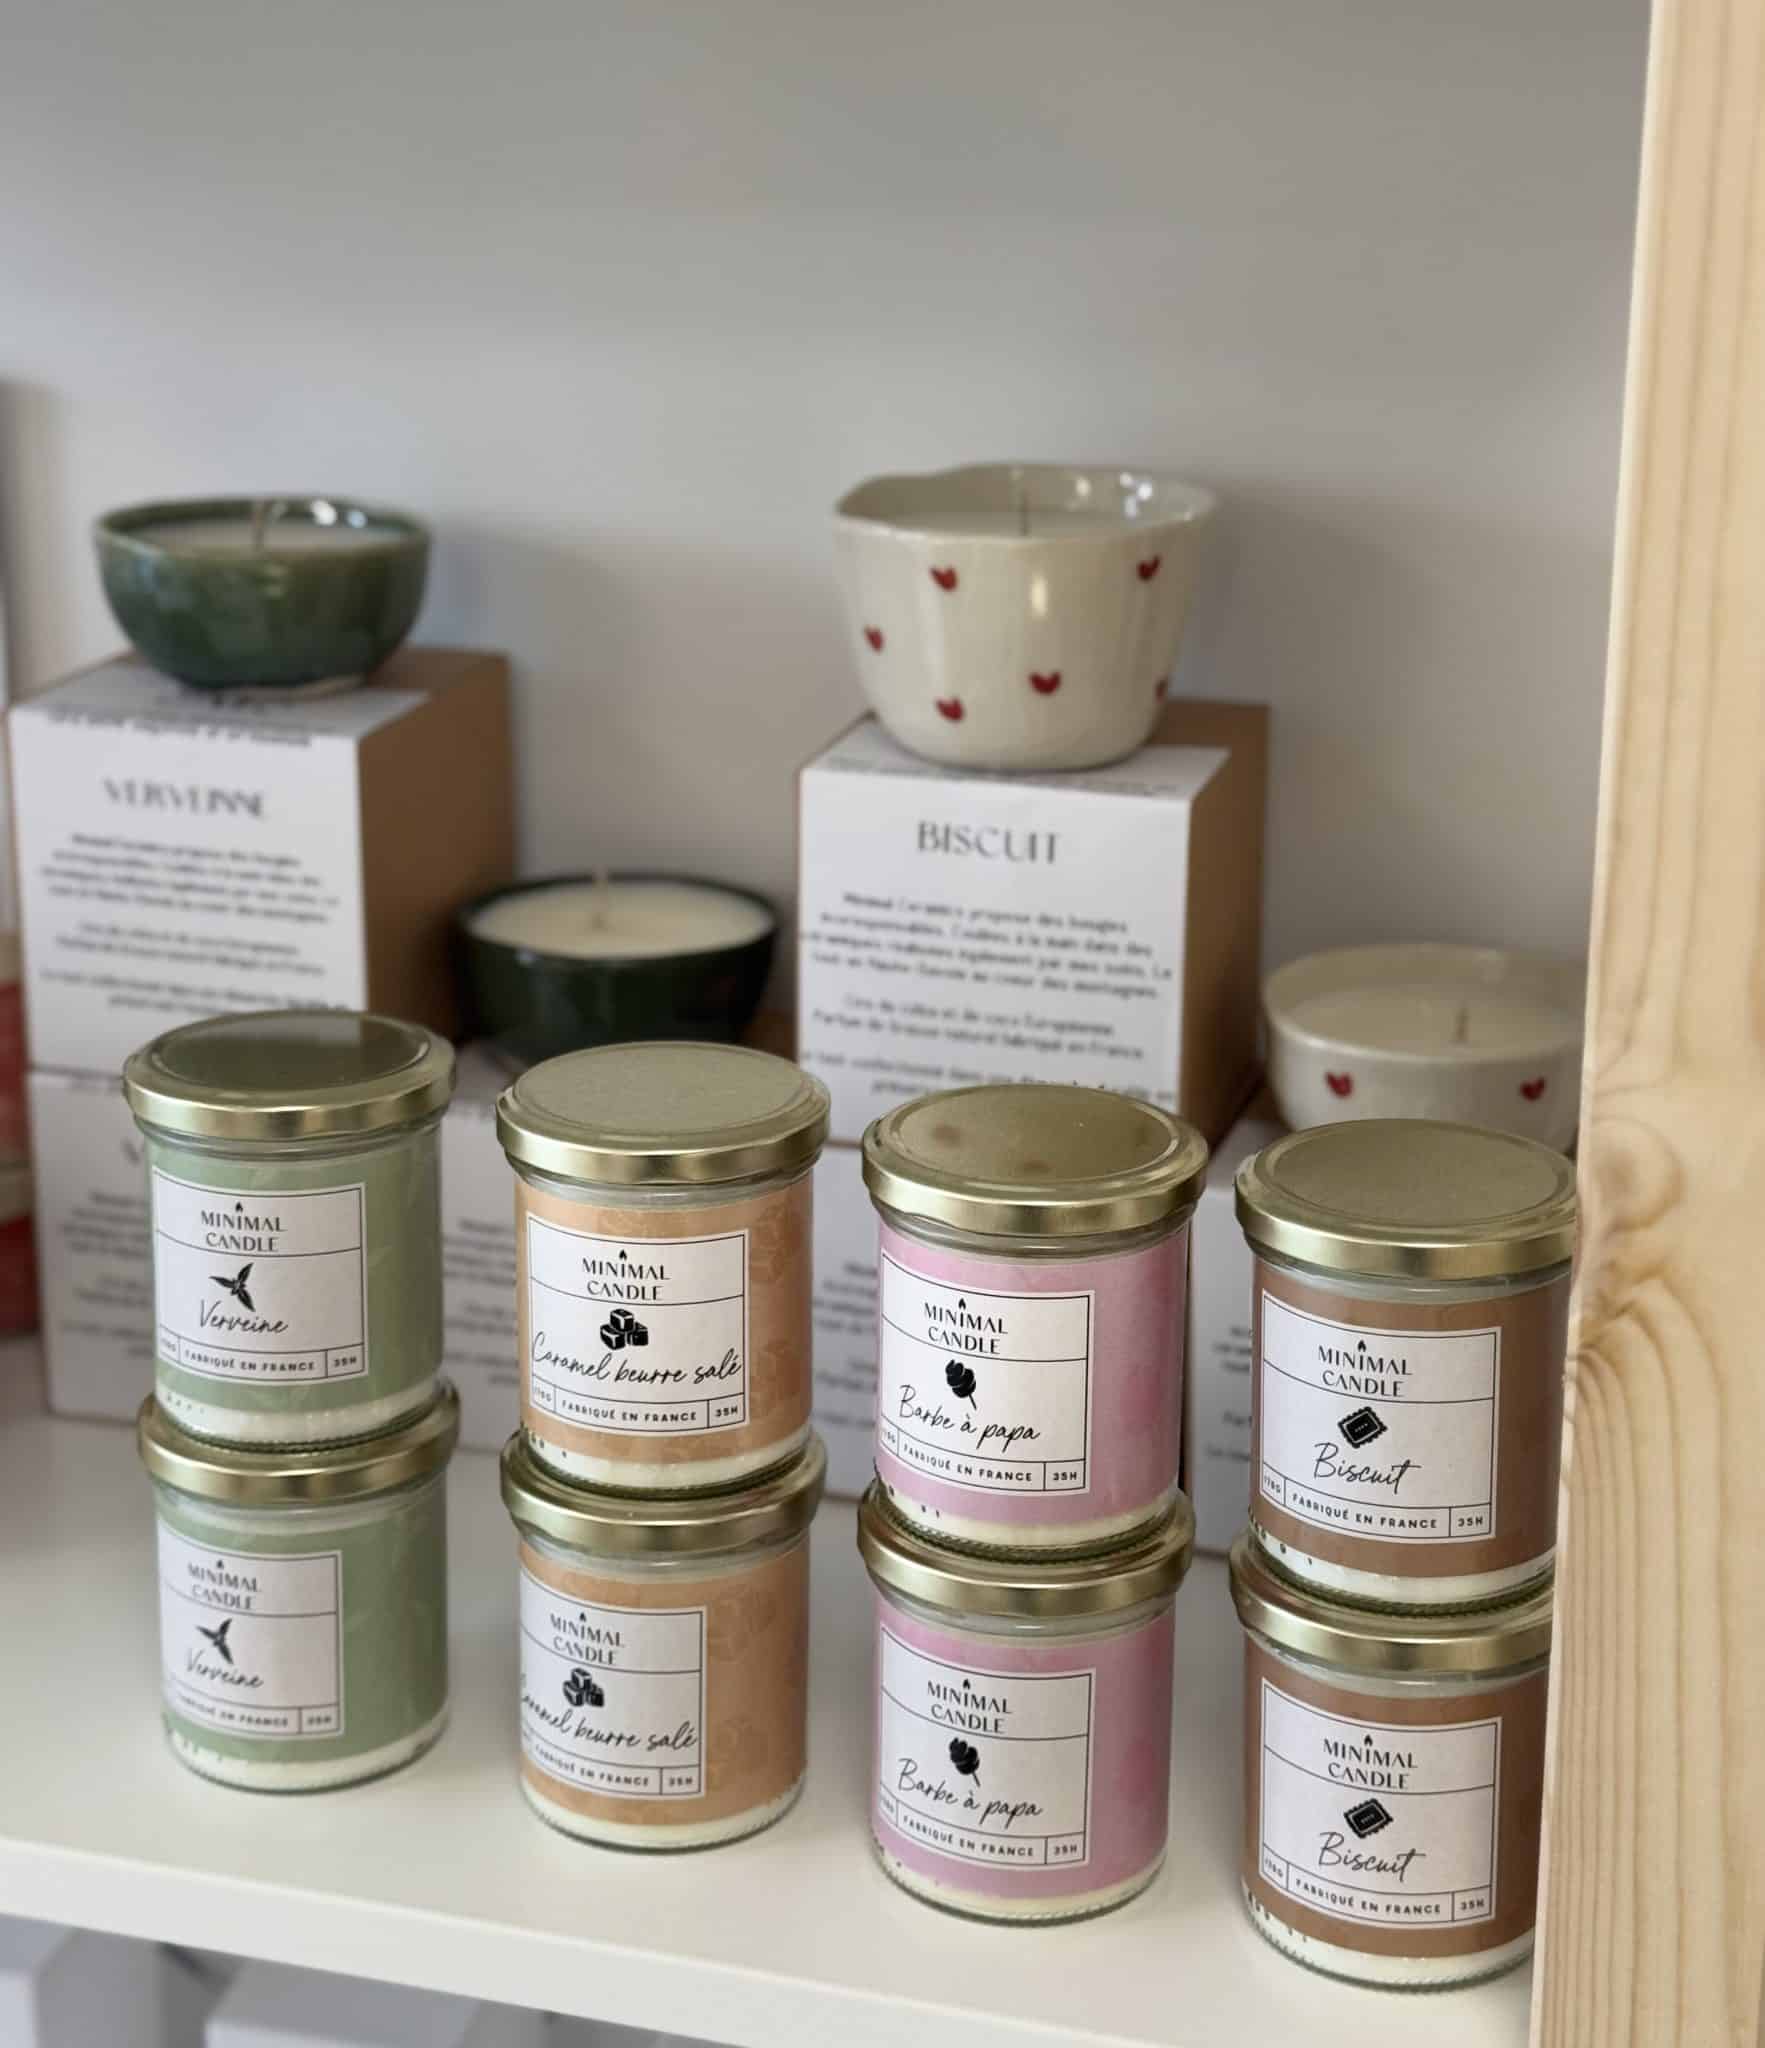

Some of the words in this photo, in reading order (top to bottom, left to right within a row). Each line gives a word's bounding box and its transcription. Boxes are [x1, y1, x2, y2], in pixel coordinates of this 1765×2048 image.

[917, 820, 1060, 862] BISCUIT
[201, 1210, 287, 1233] MINIMAL
[205, 1232, 280, 1252] CANDLE
[582, 1256, 672, 1281] MINIMAL
[587, 1280, 665, 1301] CANDLE
[199, 1299, 289, 1334] Verveine
[924, 1302, 1009, 1335] MINIMAL
[928, 1326, 1001, 1356] CANDLE
[240, 1360, 257, 1371] EN
[261, 1361, 316, 1373] FRANCE
[532, 1330, 611, 1382] Caramel
[613, 1358, 688, 1385] beurre
[692, 1347, 743, 1385] salé
[1318, 1345, 1414, 1376] MINIMAL
[1322, 1370, 1406, 1398] CANDLE
[561, 1400, 616, 1420] FABRIQUÉ
[622, 1412, 638, 1422] EN
[644, 1412, 698, 1423] FRANCE
[714, 1405, 739, 1418] 35H
[899, 1384, 955, 1430] Barbe
[960, 1414, 977, 1434] à
[976, 1424, 1041, 1454] papa
[957, 1461, 973, 1476] EN
[979, 1468, 1033, 1483] FRANCE
[1052, 1471, 1079, 1482] 35H
[1314, 1442, 1423, 1494] Biscuit
[1292, 1493, 1350, 1520] FABRIQUÉ
[1356, 1513, 1374, 1525] EN
[1380, 1516, 1438, 1529] FRANCE
[1457, 1516, 1485, 1528] 35H
[187, 1563, 262, 1593] MINIMAL
[192, 1584, 255, 1611] CANDLE
[550, 1612, 625, 1649] MINIMAL
[553, 1636, 618, 1666] CANDLE
[185, 1648, 265, 1689] Verveine
[927, 1680, 1014, 1715] MINIMAL
[930, 1703, 1006, 1735] CANDLE
[574, 1717, 641, 1747] beurre
[647, 1721, 698, 1752] salé
[1323, 1738, 1420, 1769] MINIMAL
[599, 1772, 650, 1787] FRANCE
[1328, 1762, 1411, 1790] CANDLE
[898, 1758, 959, 1806] Barbe
[963, 1789, 980, 1809] à
[979, 1800, 1044, 1830] papa
[959, 1838, 976, 1851] EN
[981, 1842, 1034, 1858] FRANCE
[1318, 1831, 1427, 1883] Biscuit
[1296, 1879, 1354, 1908] FABRIQUÉ
[1361, 1901, 1379, 1913] EN
[1386, 1902, 1441, 1915] FRANCE
[1459, 1898, 1485, 1912] 35H
